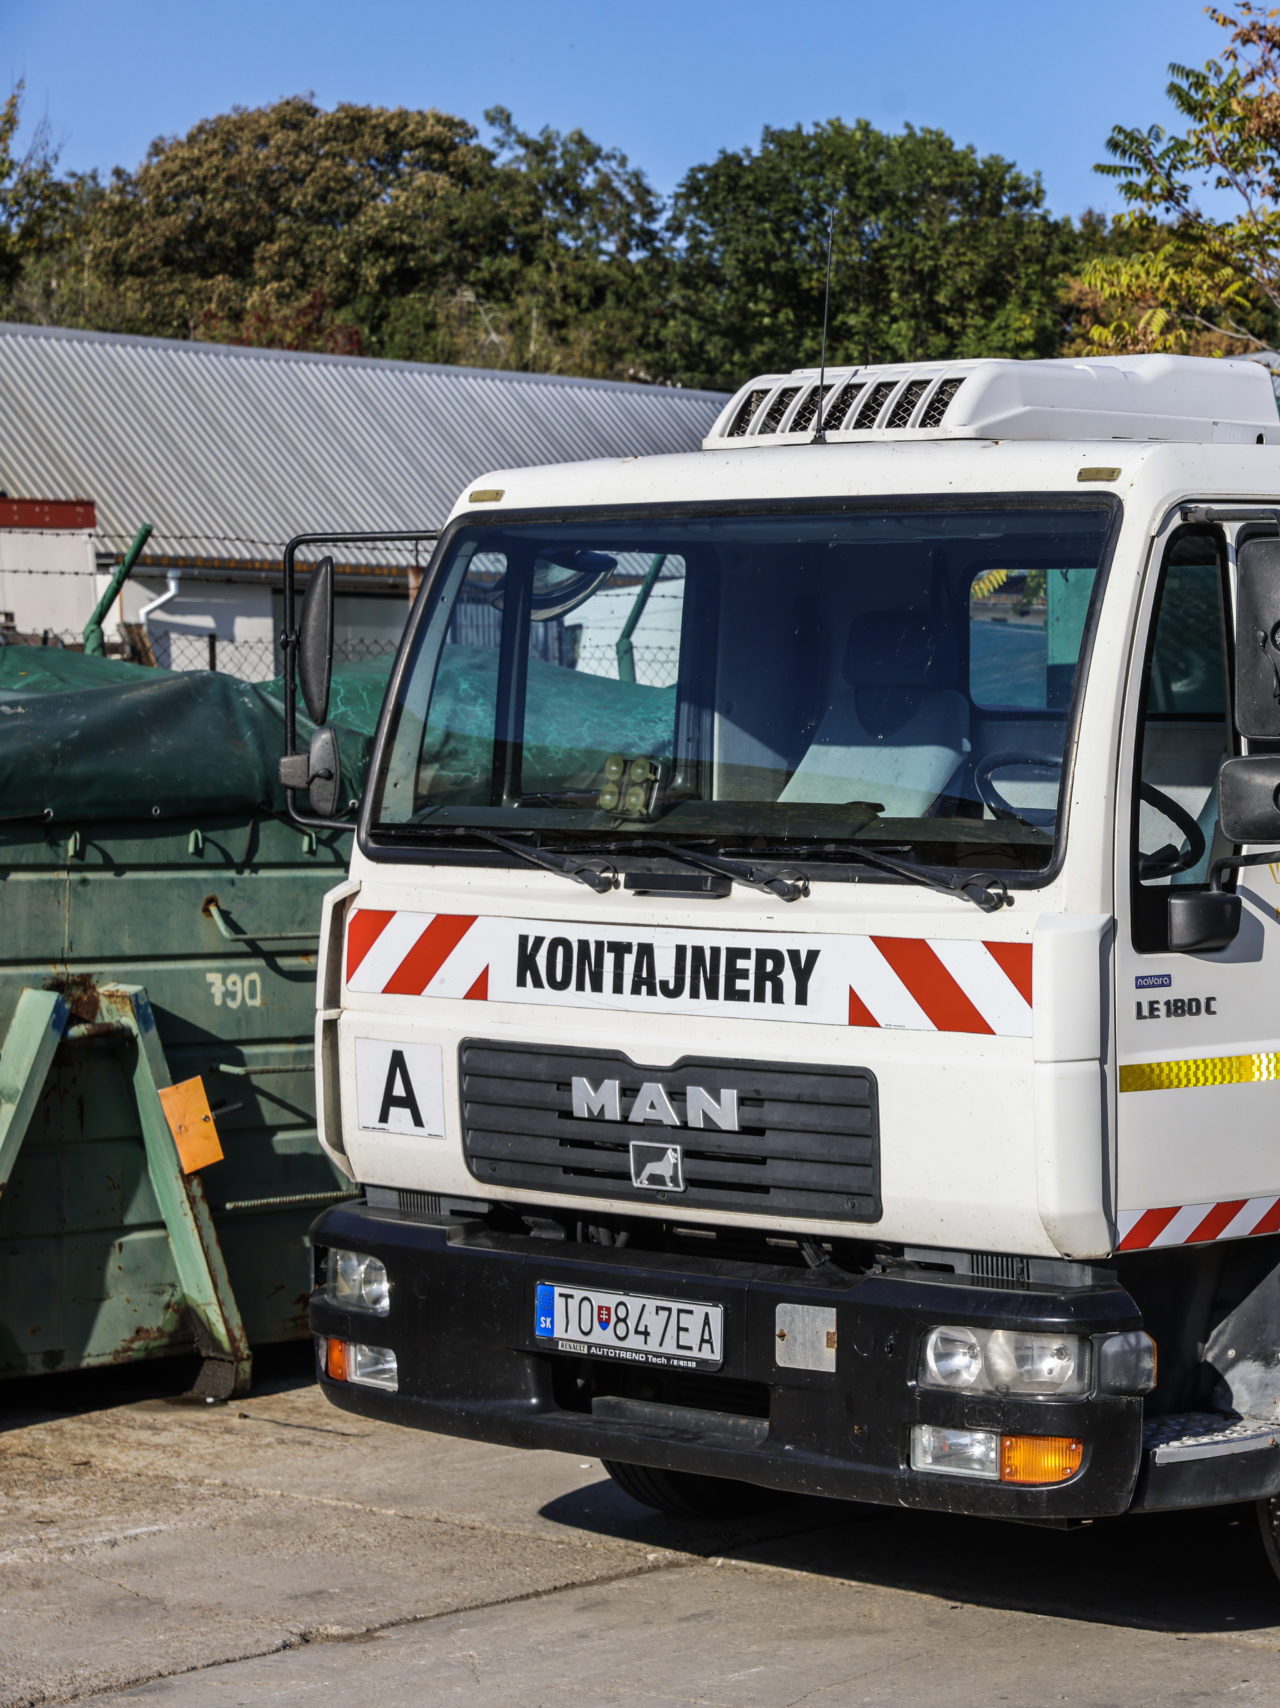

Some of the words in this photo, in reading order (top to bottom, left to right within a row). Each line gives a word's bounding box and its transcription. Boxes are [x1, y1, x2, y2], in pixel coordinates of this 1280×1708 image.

[206, 971, 262, 1009] 790
[516, 933, 821, 1006] KONTAJNERY
[1136, 1000, 1161, 1020] LE
[1164, 997, 1202, 1018] 180
[1205, 996, 1217, 1015] C
[377, 1049, 425, 1129] A
[570, 1076, 739, 1132] MAN
[540, 1316, 552, 1329] SK
[558, 1292, 594, 1337] TO
[613, 1300, 715, 1354] 847EA
[560, 1341, 586, 1353] RENAULT
[590, 1346, 646, 1361] AUTOTREND
[647, 1354, 668, 1366] Tech
